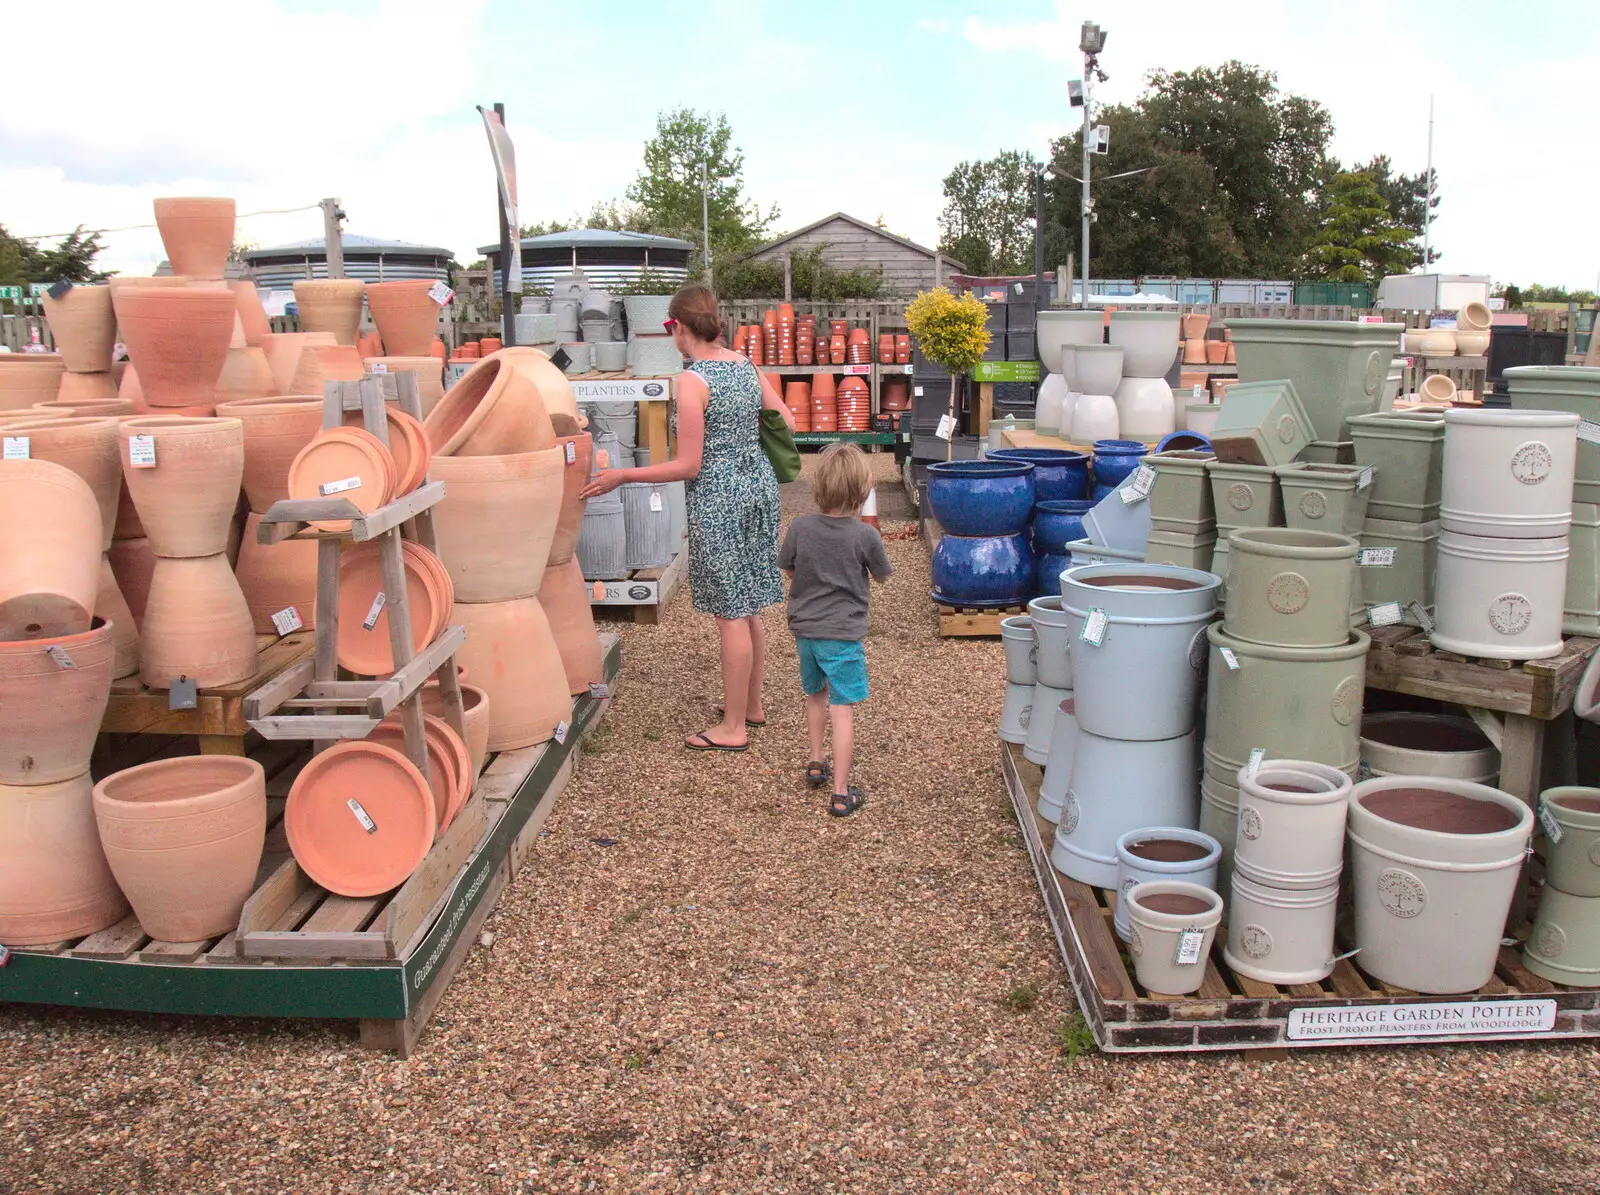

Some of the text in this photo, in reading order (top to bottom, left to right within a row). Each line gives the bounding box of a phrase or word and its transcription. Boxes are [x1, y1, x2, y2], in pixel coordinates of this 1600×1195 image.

[578, 385, 636, 396] PLANTERS
[414, 860, 490, 989] Guaranteed frost resistant
[1301, 1004, 1545, 1025] HERITAGE GARDEN POTTERY
[1300, 1018, 1543, 1035] FROST PROOF PLANTERS FROM WOODLODGE
